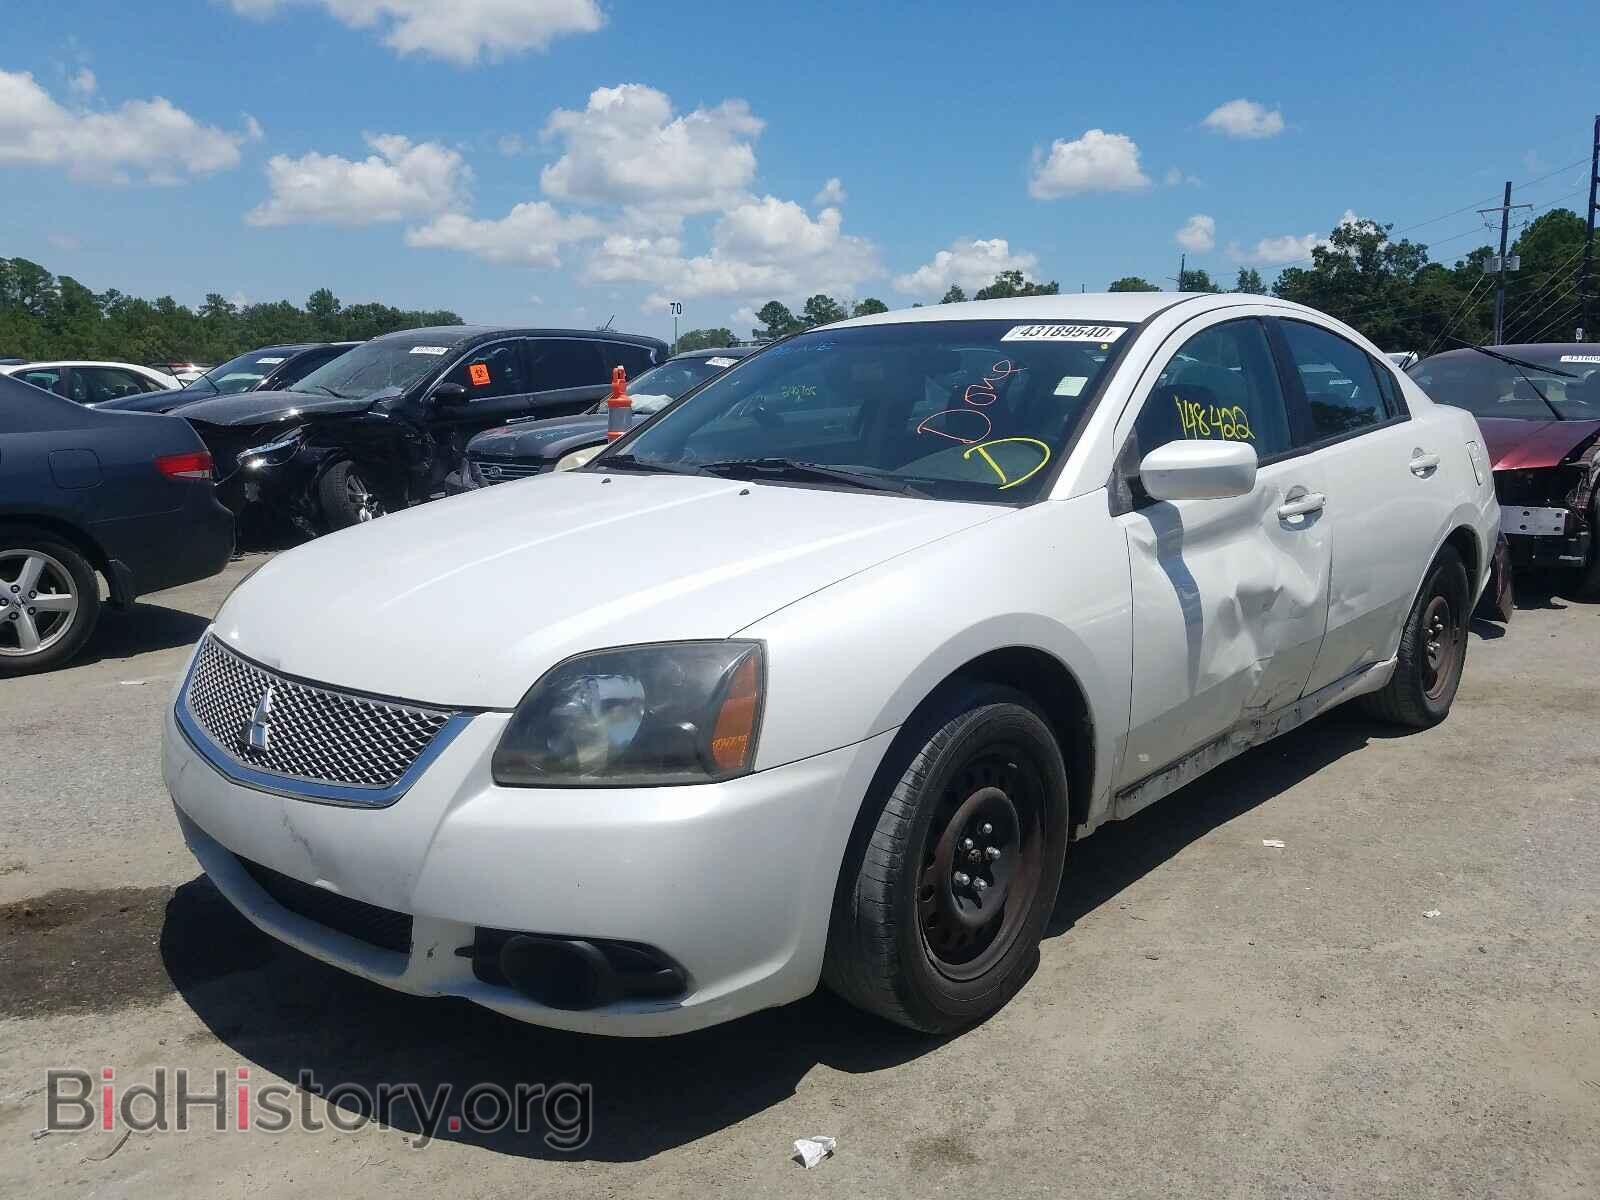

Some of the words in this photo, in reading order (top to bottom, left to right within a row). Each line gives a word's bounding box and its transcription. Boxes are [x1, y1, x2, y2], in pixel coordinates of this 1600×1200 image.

[670, 302, 682, 314] 70
[1020, 325, 1109, 338] 43189540
[917, 359, 1028, 444] Done
[963, 437, 1051, 490] D
